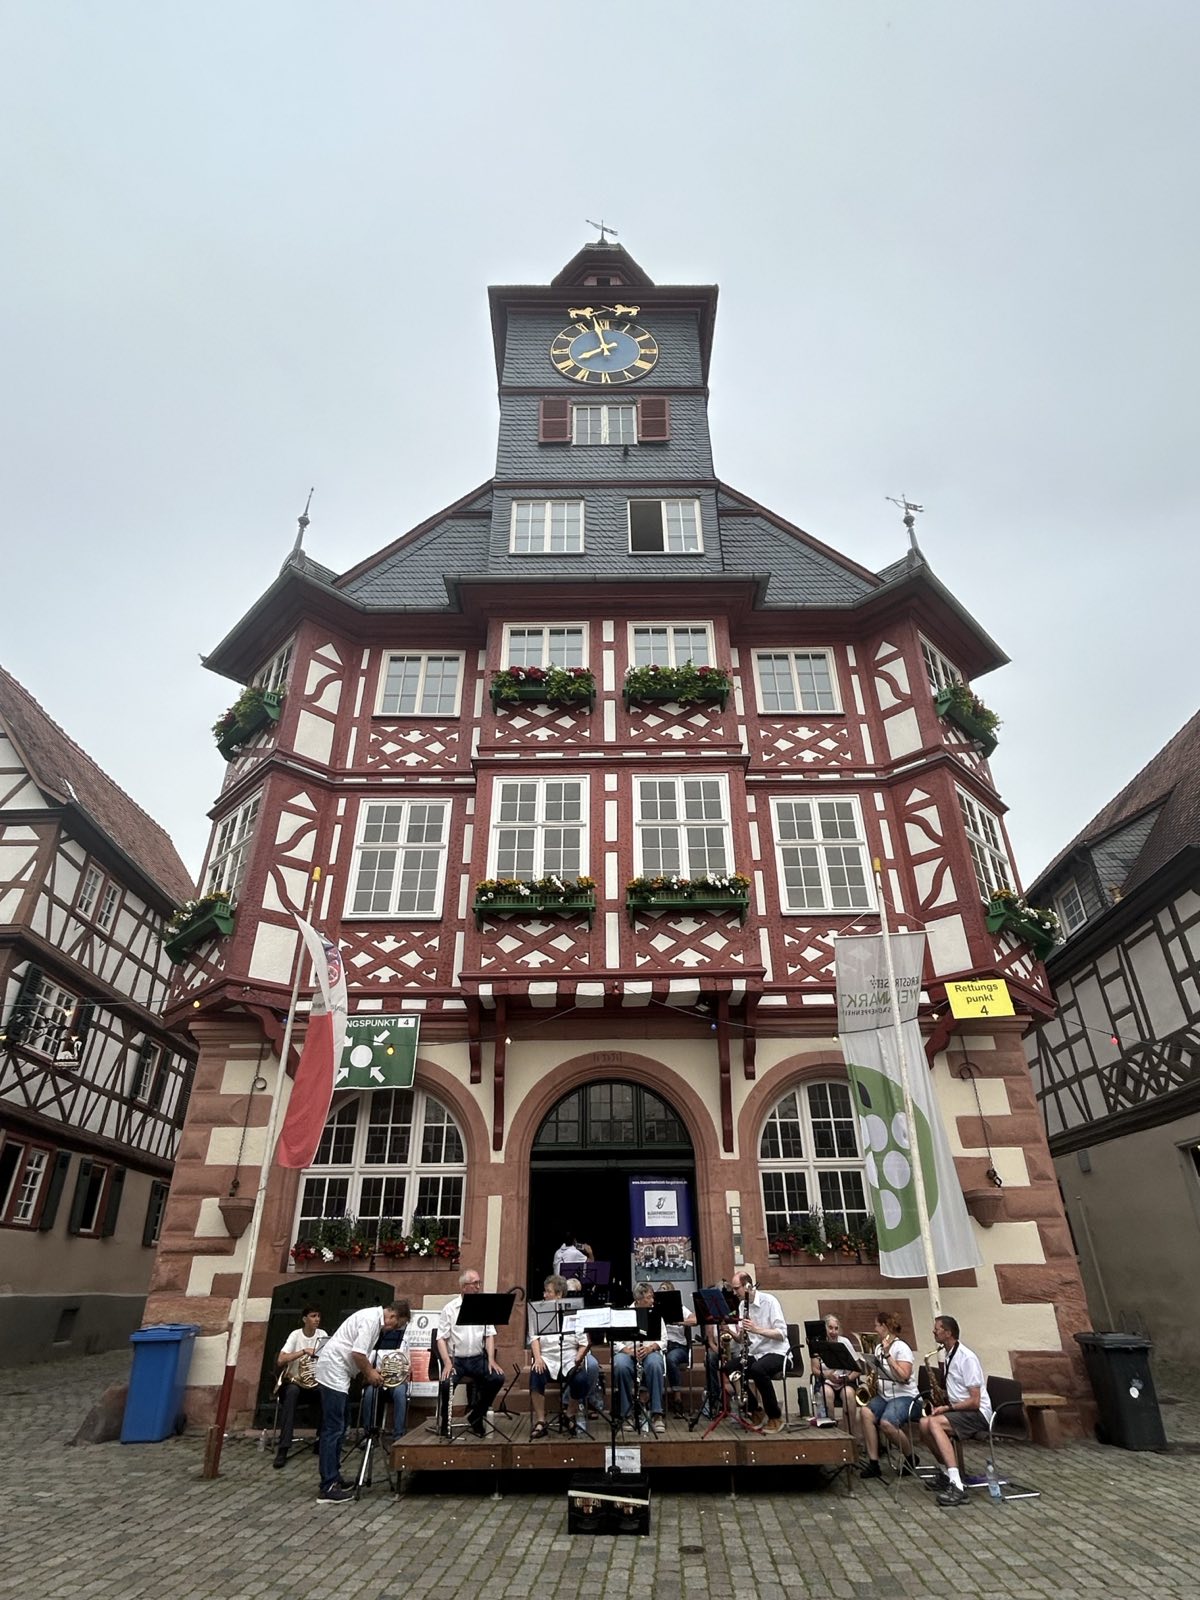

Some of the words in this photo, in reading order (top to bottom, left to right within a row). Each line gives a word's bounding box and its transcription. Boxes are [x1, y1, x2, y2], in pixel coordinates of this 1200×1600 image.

[954, 983, 999, 993] Rettungs
[966, 993, 995, 1004] punkt
[980, 1005, 989, 1016] 4
[346, 1019, 397, 1028] NGSPUNKT
[403, 1018, 410, 1026] 4
